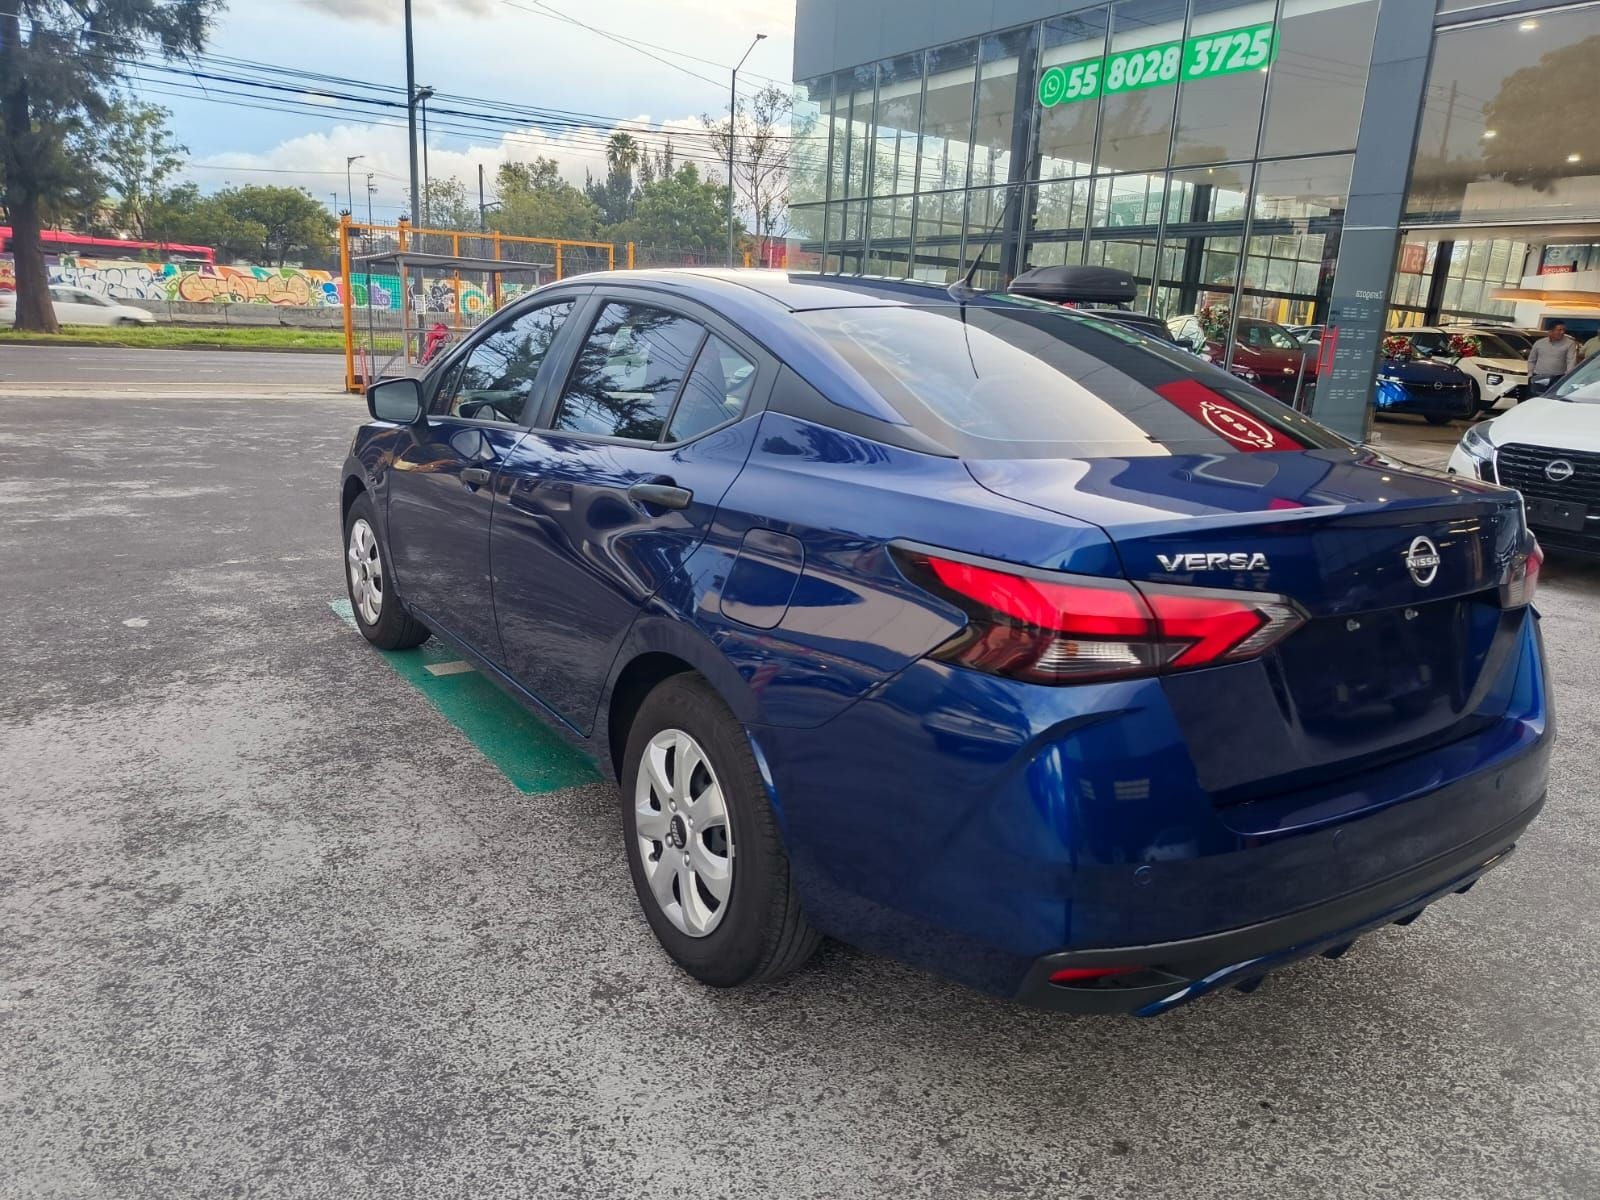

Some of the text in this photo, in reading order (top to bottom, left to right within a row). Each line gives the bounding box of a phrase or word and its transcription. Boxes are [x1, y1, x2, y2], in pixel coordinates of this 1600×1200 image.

[1067, 29, 1272, 98] 55 8028 3725
[1156, 552, 1270, 572] VERSA
